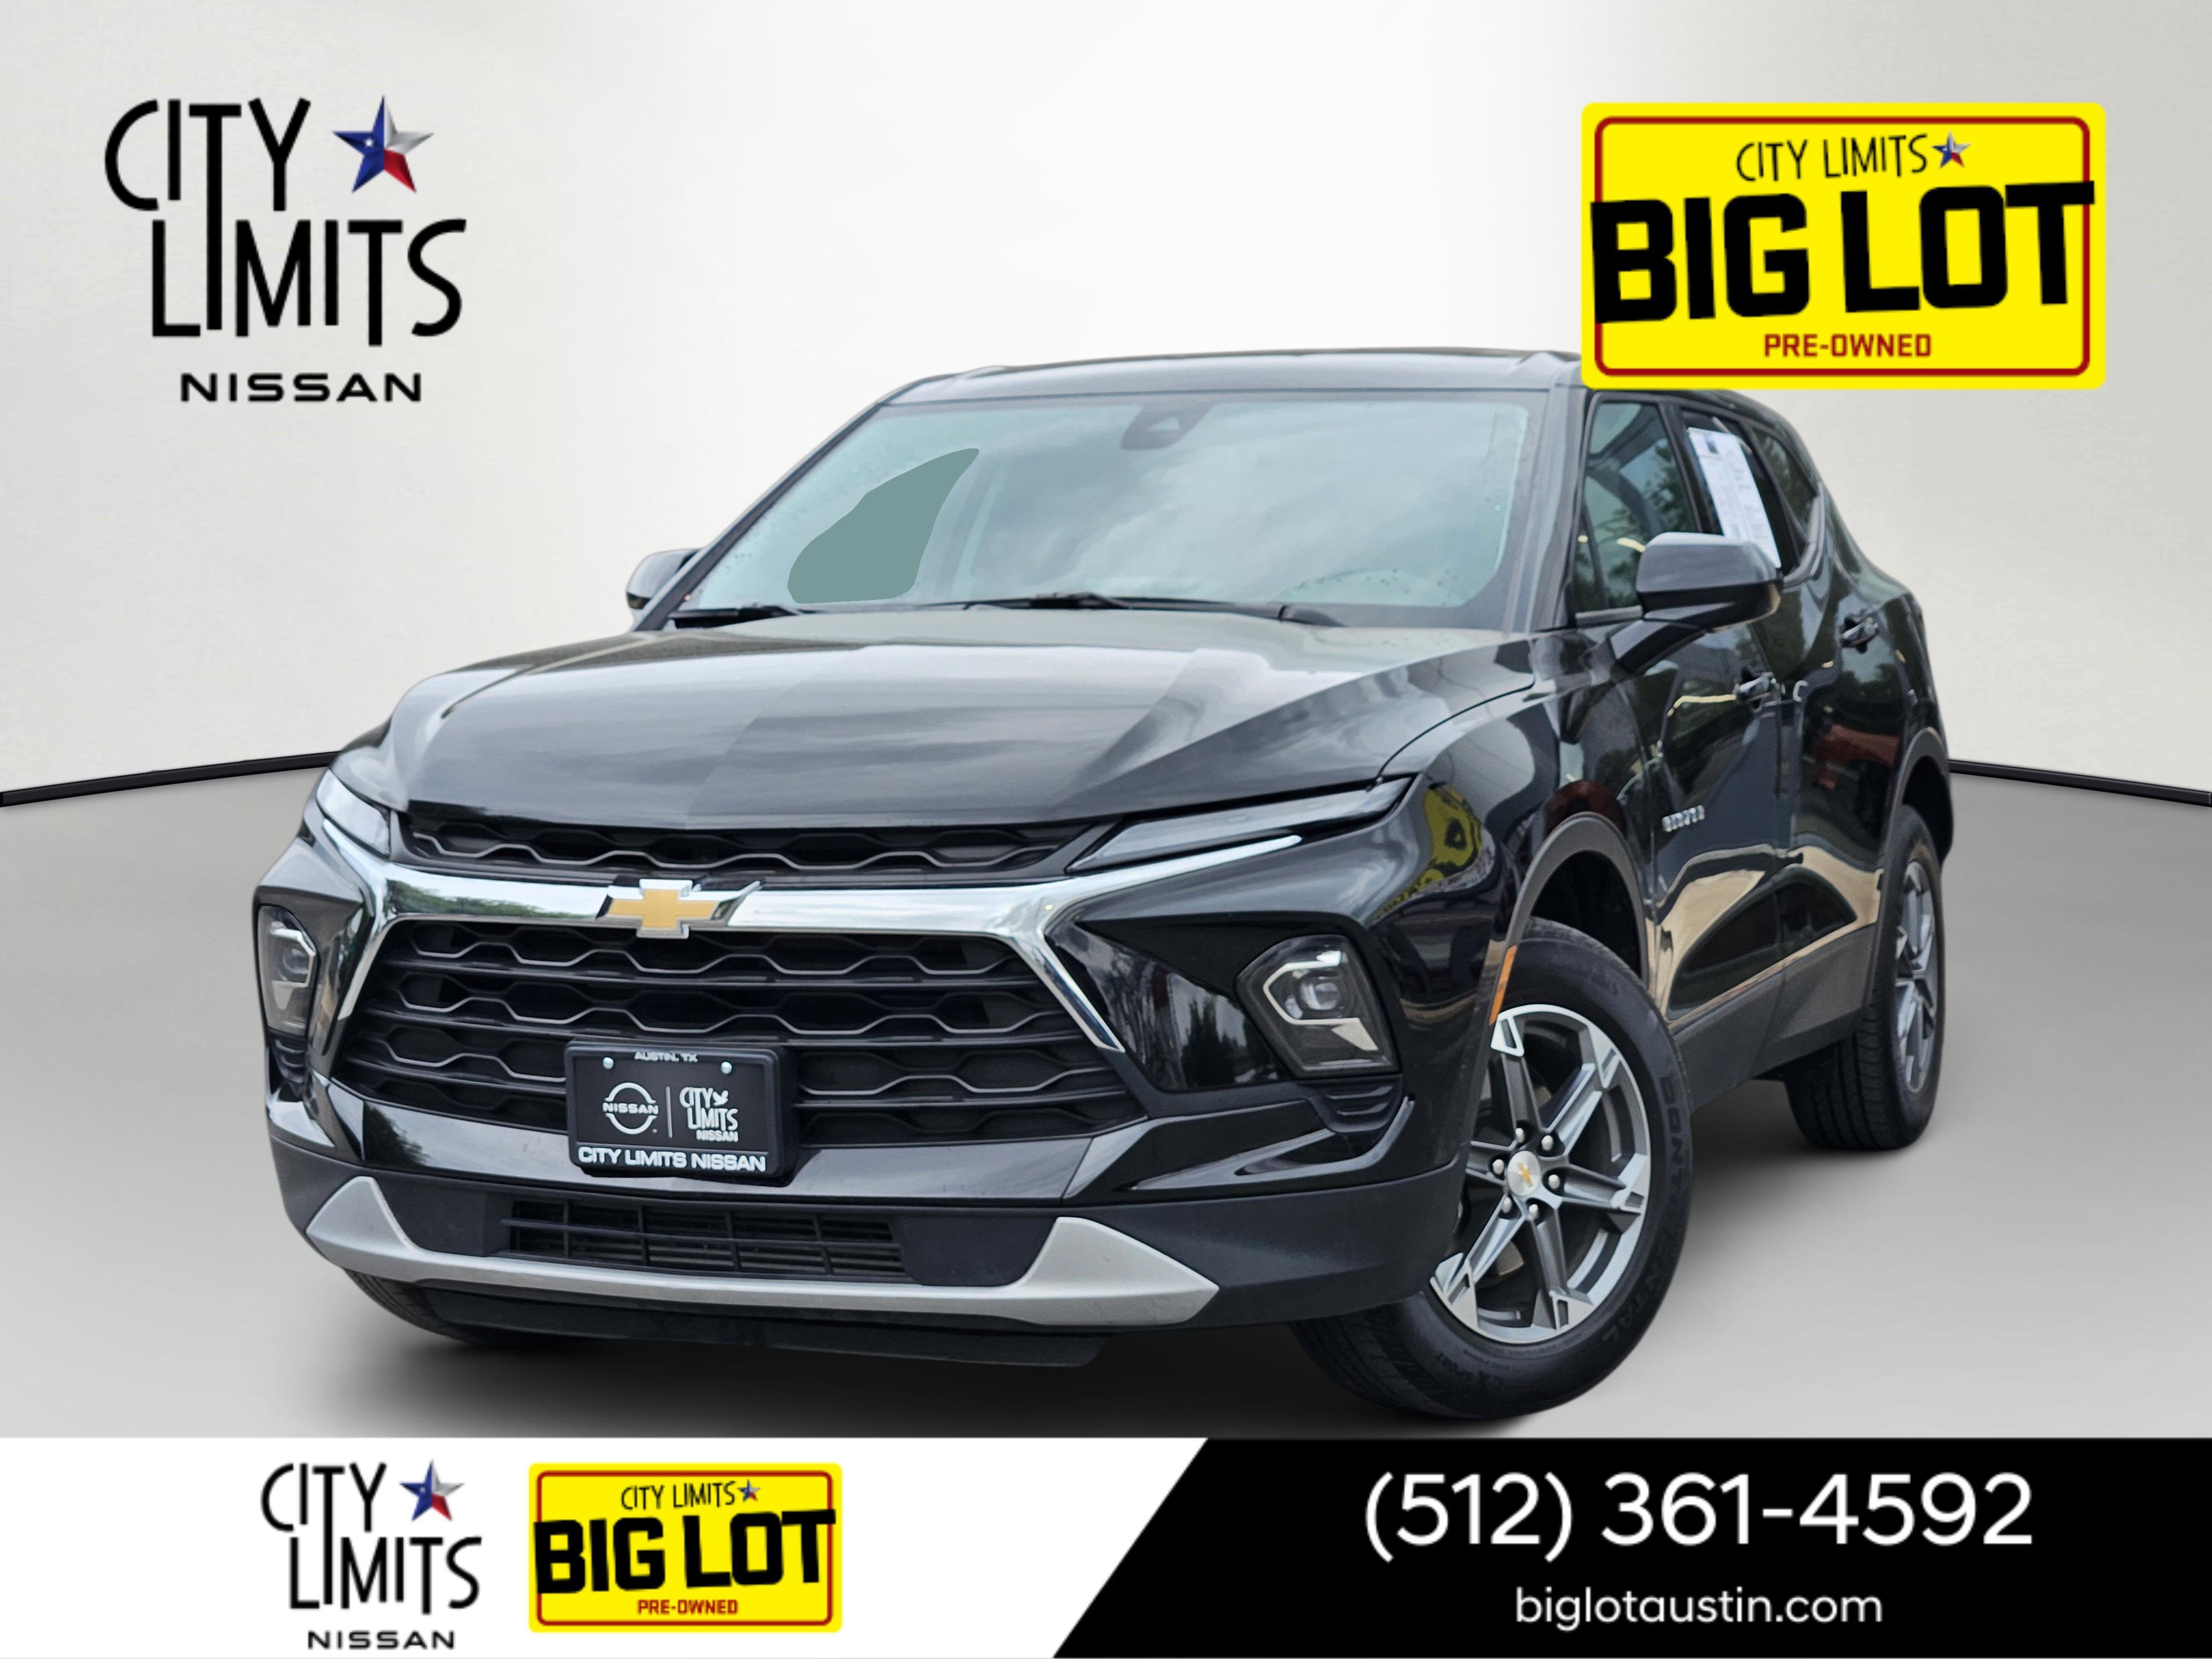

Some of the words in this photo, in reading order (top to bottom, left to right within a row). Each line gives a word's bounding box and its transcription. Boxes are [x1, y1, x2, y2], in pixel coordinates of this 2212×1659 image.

[680, 1053, 698, 1063] TX
[680, 1087, 713, 1109] CITY
[602, 1102, 659, 1115] NISSAN
[687, 1107, 738, 1131] LIMITS
[696, 1129, 738, 1142] NISSAN
[578, 1146, 622, 1164] CITY
[625, 1150, 687, 1168] LIMITS
[691, 1153, 766, 1172] NISSAN
